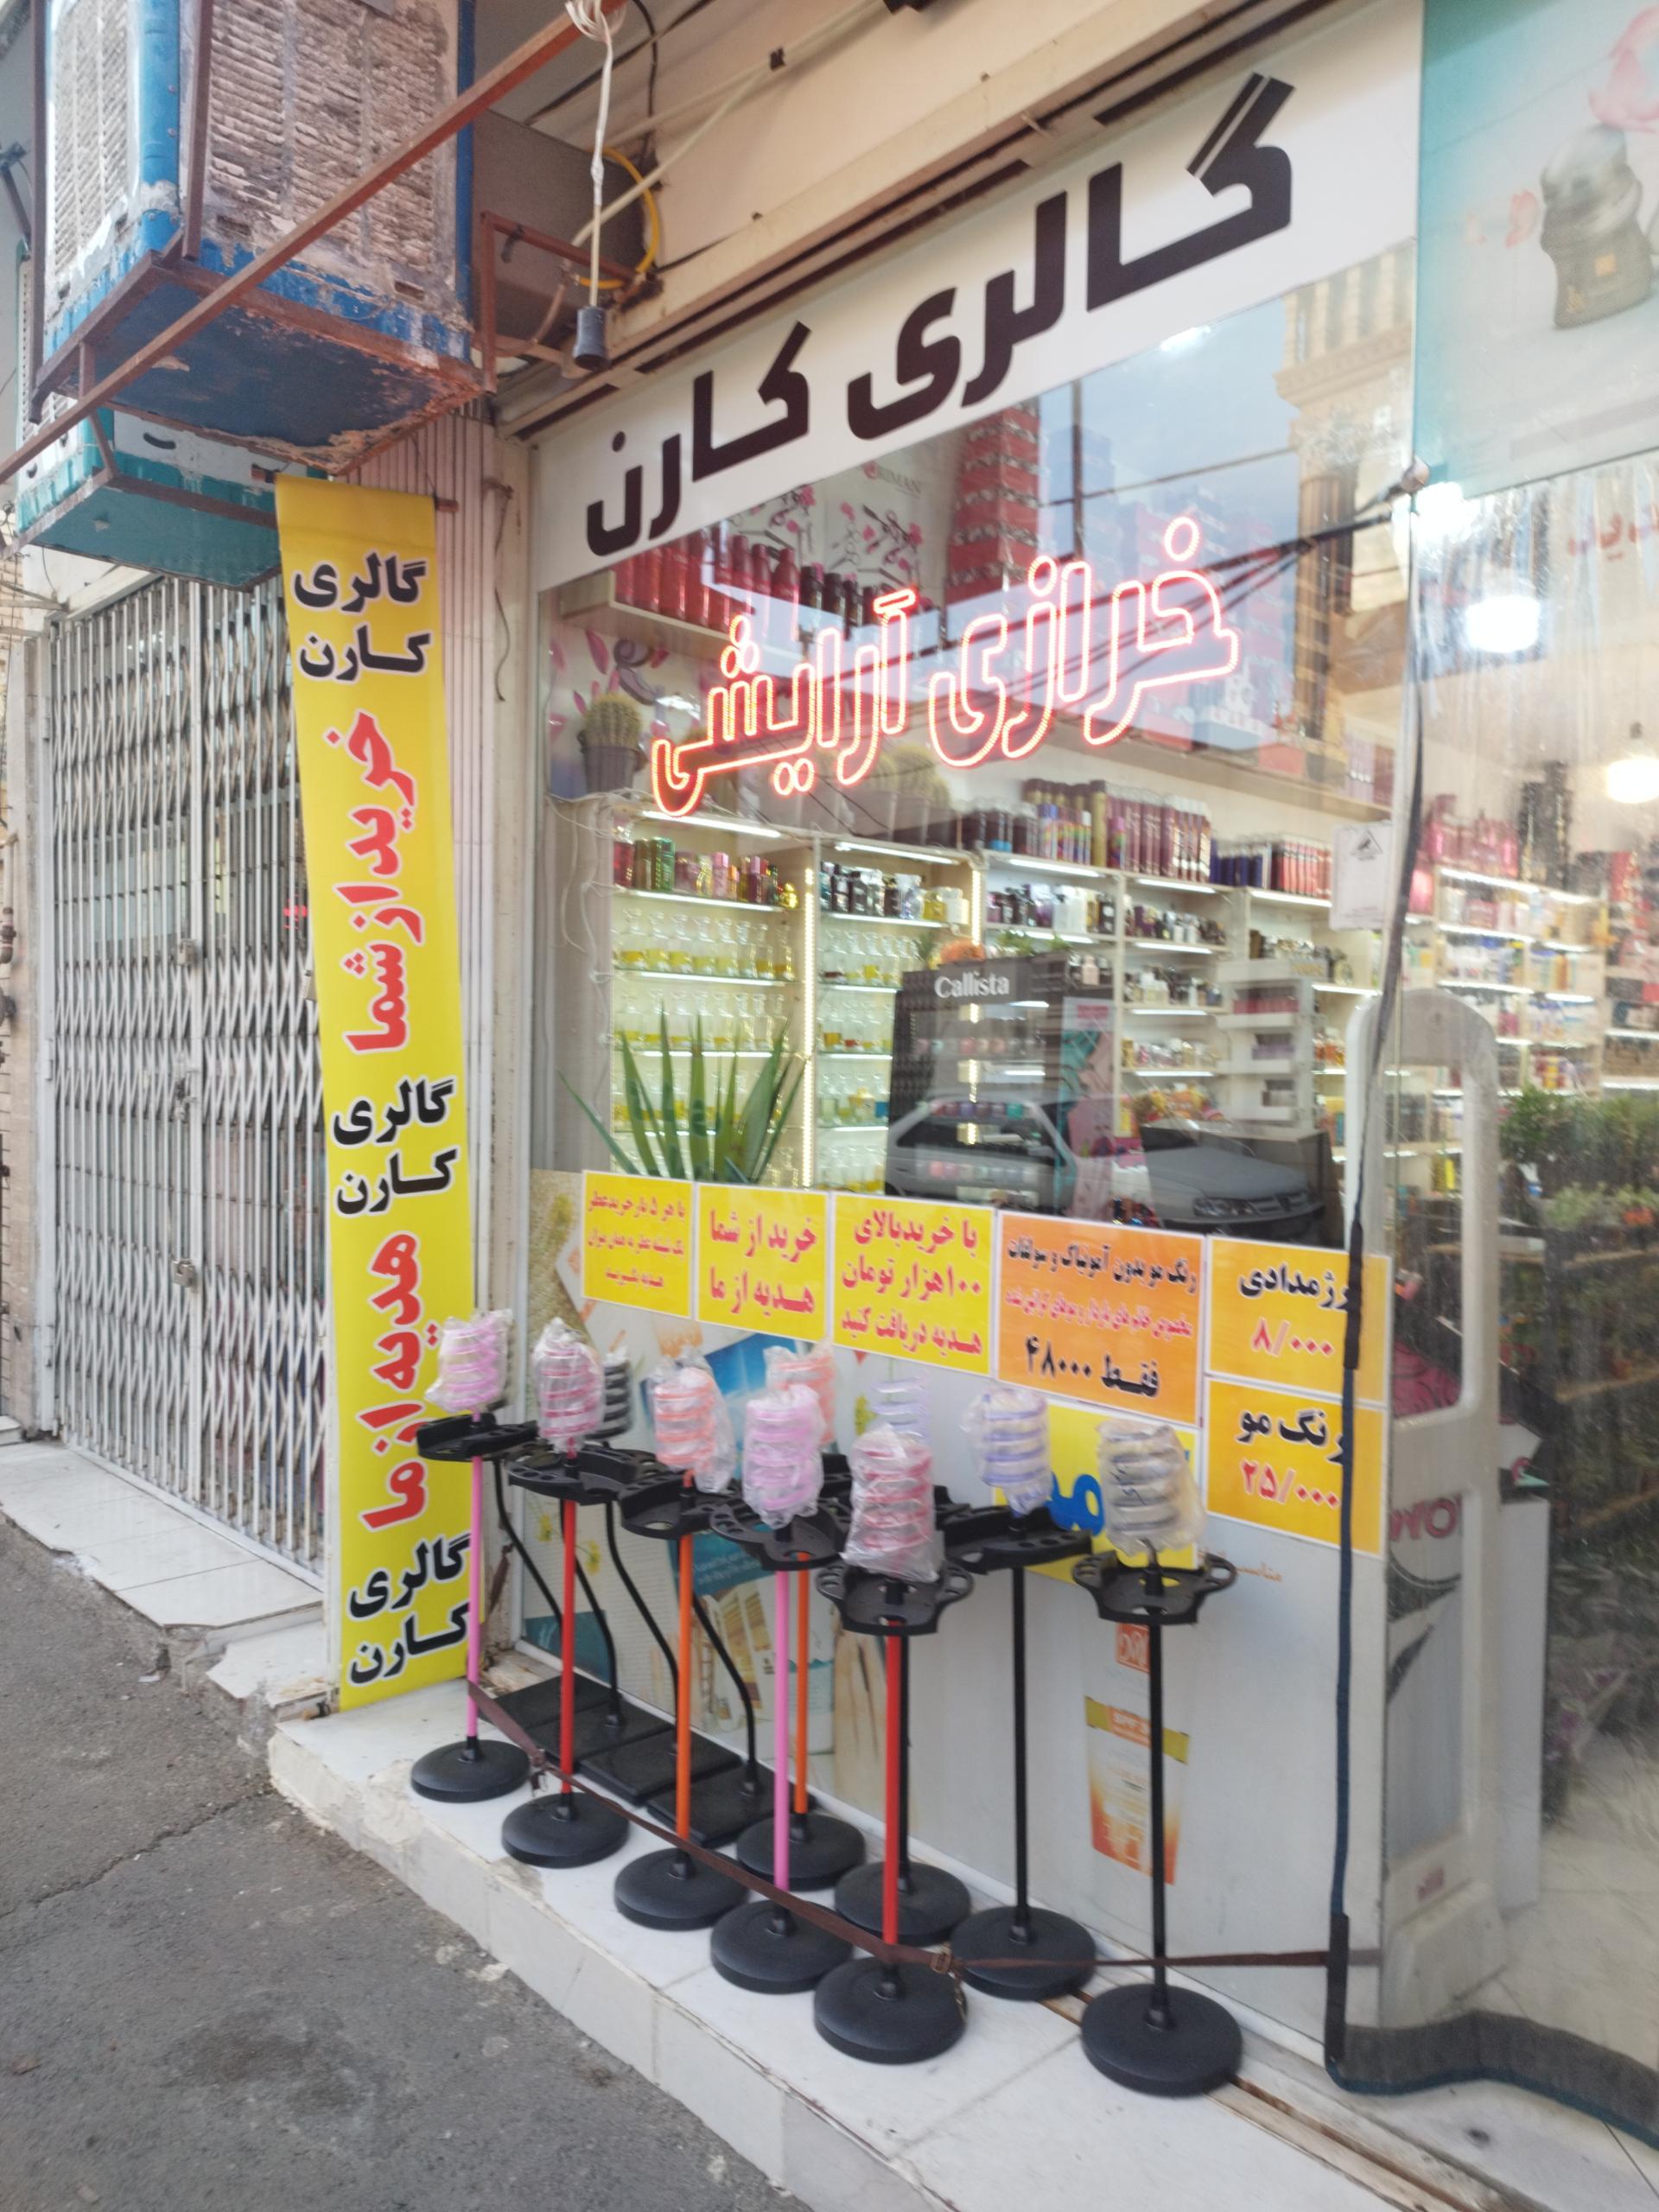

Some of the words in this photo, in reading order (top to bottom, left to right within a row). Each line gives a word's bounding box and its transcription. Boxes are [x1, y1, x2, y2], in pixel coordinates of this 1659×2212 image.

[848, 72, 1295, 441] گالری
[586, 321, 811, 556] کارن
[295, 552, 426, 613] گالری
[299, 626, 430, 681] کارن
[927, 516, 1240, 767] خرازی
[652, 588, 916, 816] آرایشی
[327, 713, 416, 876] خرید
[339, 885, 422, 942] از
[344, 943, 407, 1052] شما
[934, 970, 1010, 998] Callista
[334, 1079, 454, 1145] گالری
[336, 1149, 457, 1215] کارن
[710, 1208, 740, 1243] شما
[745, 1213, 761, 1258] از
[768, 1217, 817, 1263] خرید
[962, 1218, 978, 1258] با
[710, 1266, 726, 1300] ما
[730, 1270, 748, 1314] از
[842, 1253, 896, 1294] تومان
[1238, 1262, 1319, 1298] مدادی
[372, 1234, 438, 1390] هدیه
[754, 1281, 815, 1318] هدیه
[841, 1306, 873, 1339] کنید
[874, 1307, 928, 1353] دریافت
[931, 1325, 983, 1358] هدیه
[1025, 1334, 1094, 1380] ۴۸۰۰۰
[1101, 1353, 1160, 1398] فقط
[1236, 1410, 1272, 1443] مو
[363, 1461, 425, 1529] ما
[350, 1533, 472, 1619] گالری
[351, 1602, 470, 1684] کارن
